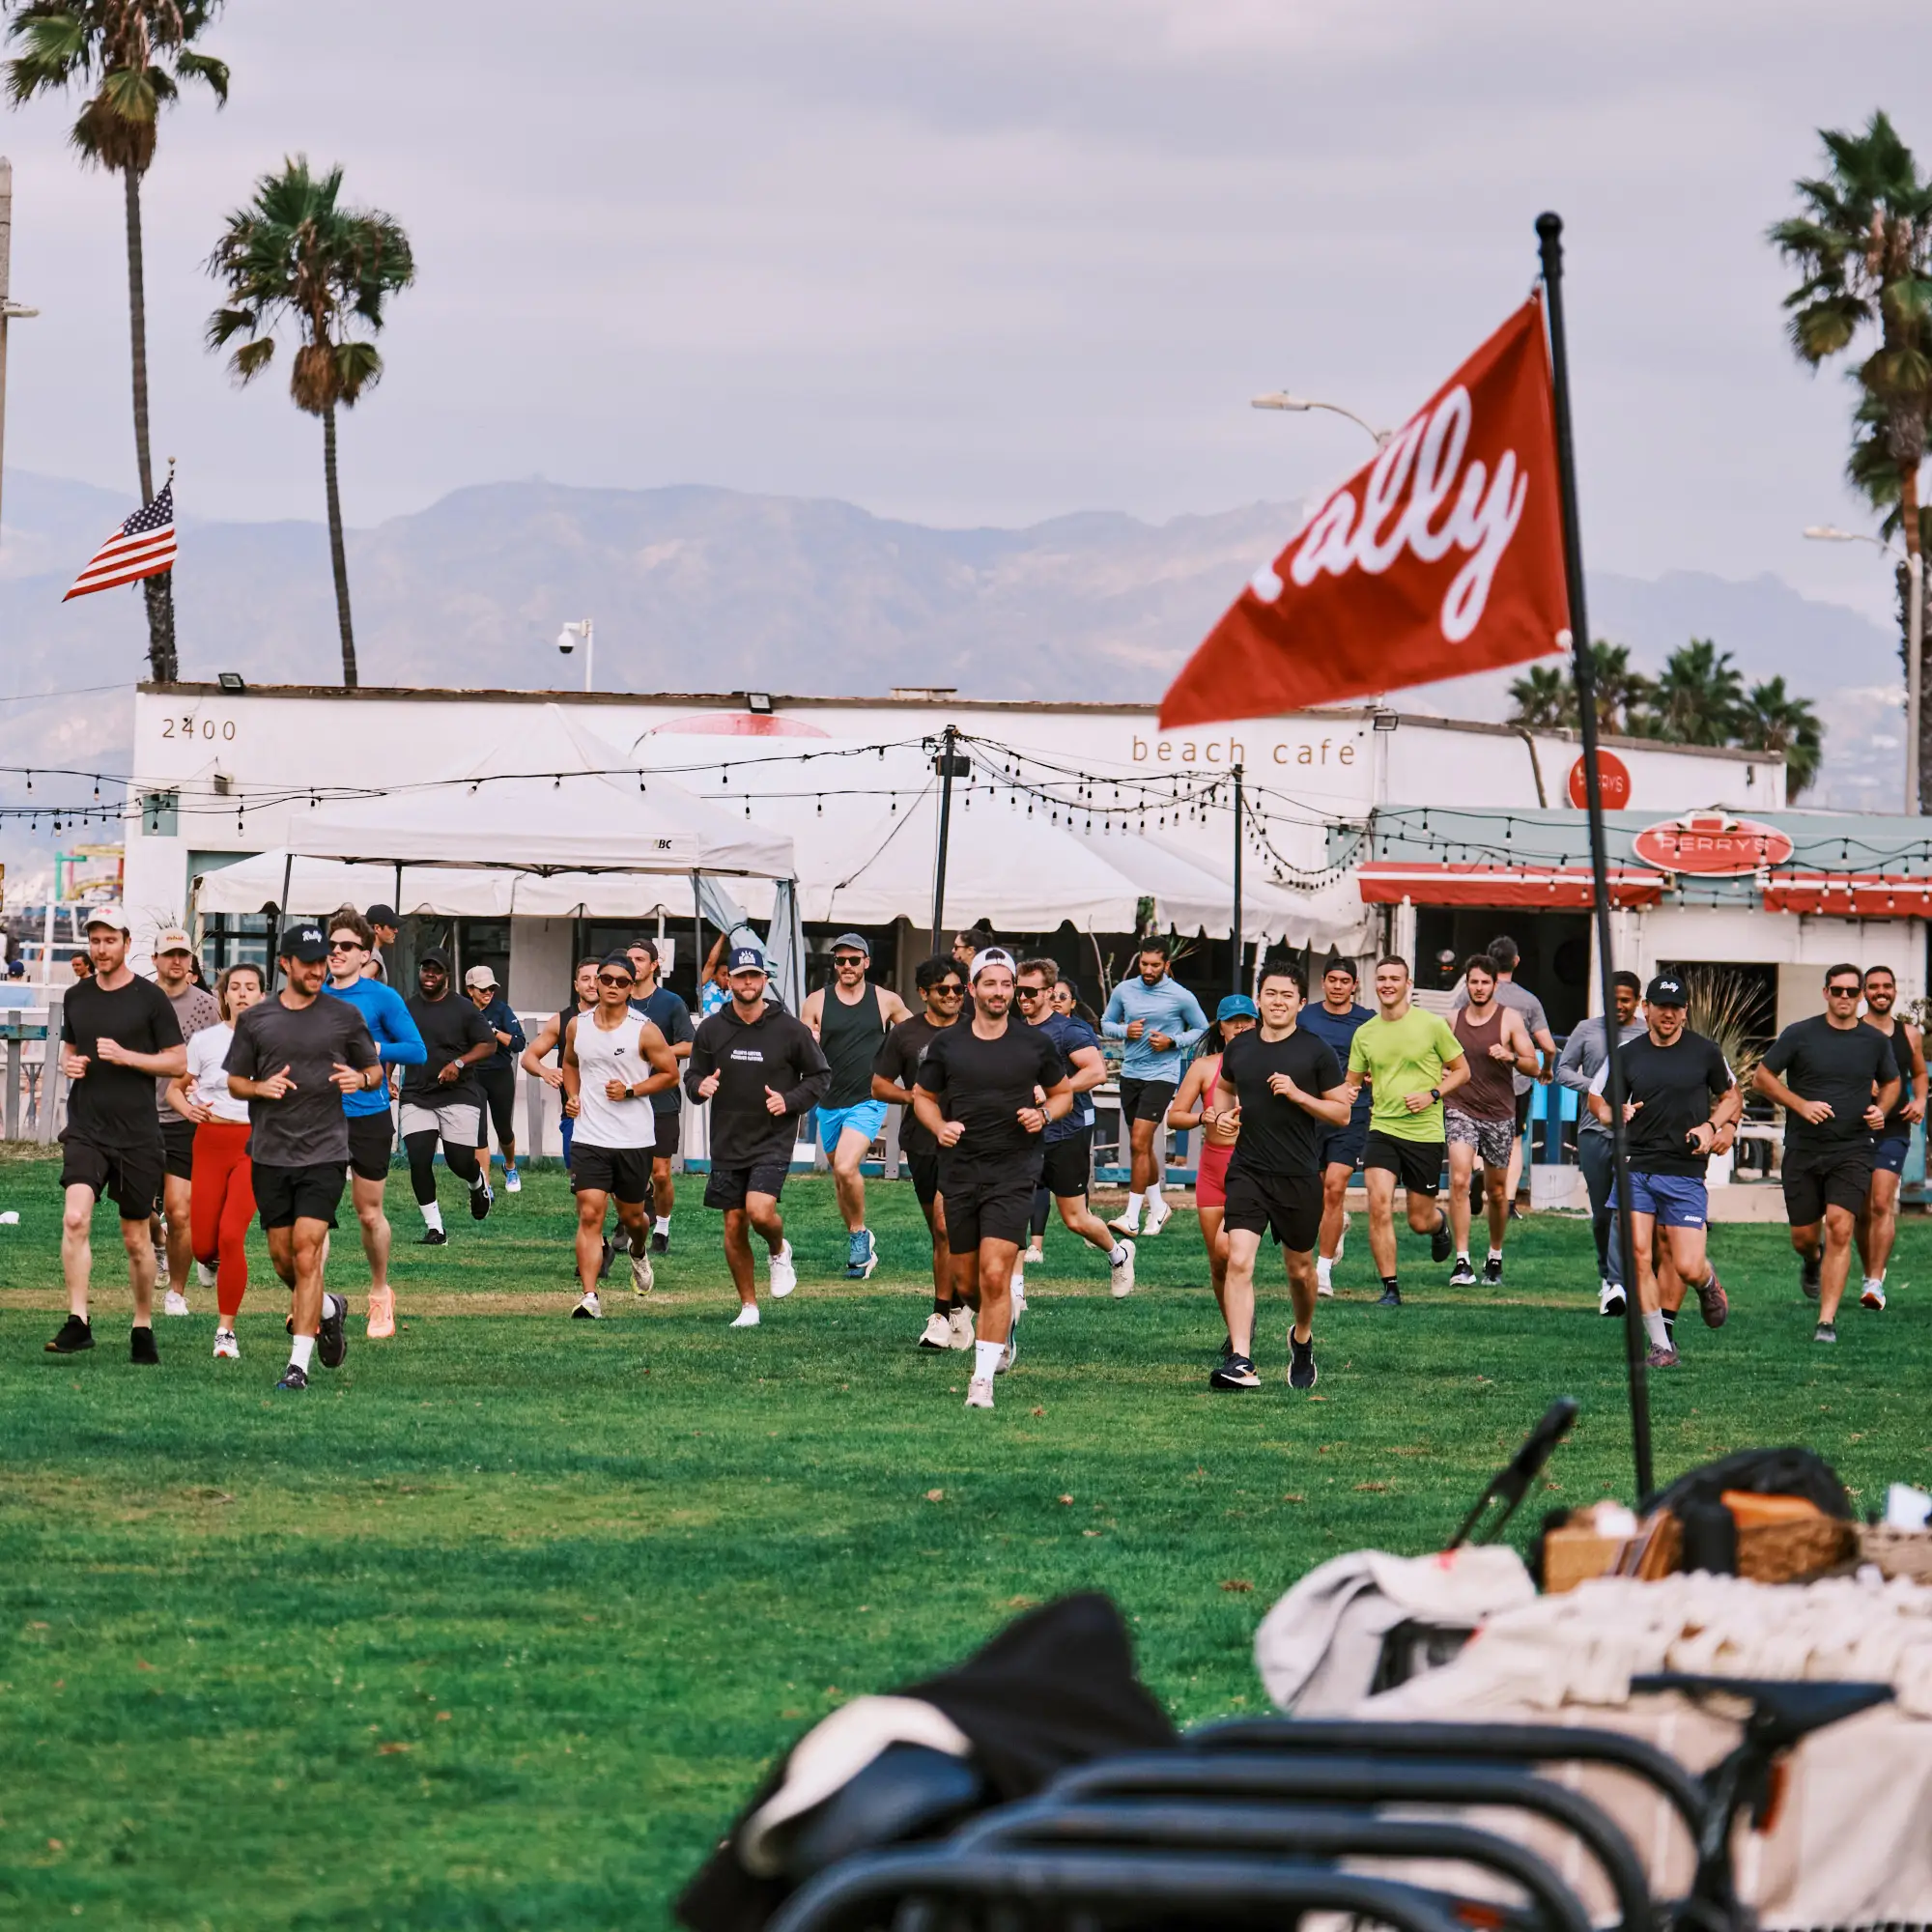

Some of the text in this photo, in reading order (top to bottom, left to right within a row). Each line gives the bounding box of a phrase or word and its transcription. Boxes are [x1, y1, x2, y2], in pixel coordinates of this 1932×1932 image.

[1252, 384, 1528, 643] ally
[162, 718, 236, 740] 2400
[1132, 735, 1245, 763] beach
